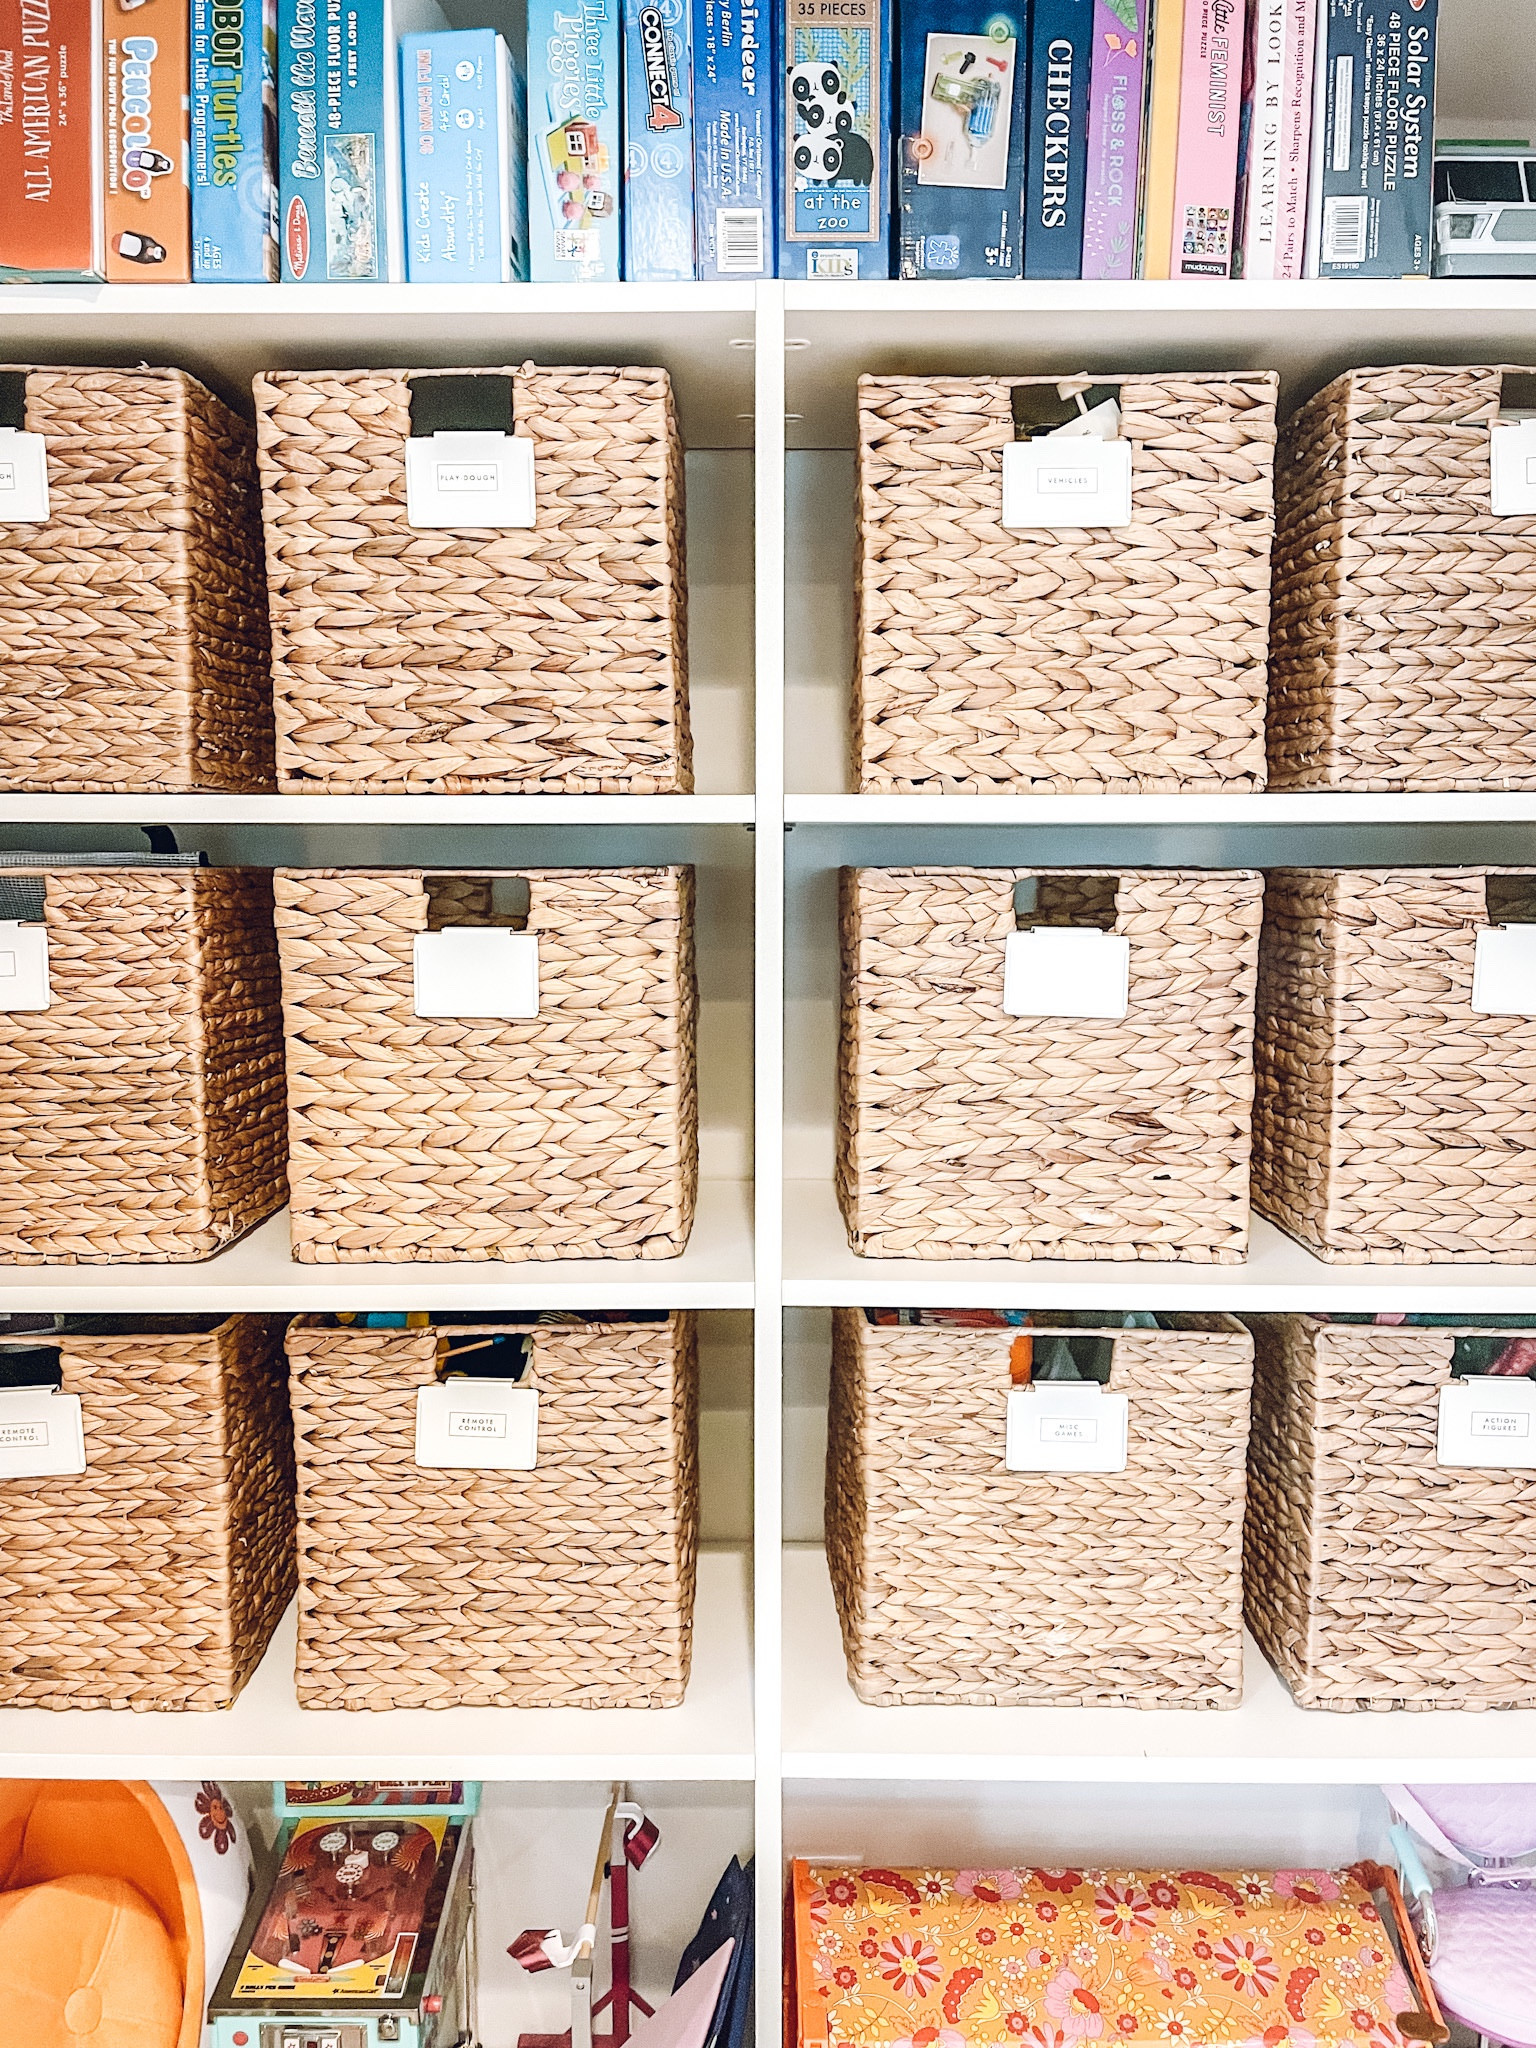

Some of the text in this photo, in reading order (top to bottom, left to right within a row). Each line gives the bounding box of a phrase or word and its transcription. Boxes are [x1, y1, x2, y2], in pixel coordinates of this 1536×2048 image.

[798, 3, 866, 16] 35 PIECES
[1201, 9, 1209, 29] PIECE
[327, 23, 341, 67] FLOOR
[722, 11, 733, 47] Berlin
[1200, 31, 1208, 58] PUZZLE
[1376, 33, 1386, 46] 36
[0, 49, 13, 72] Nod
[58, 44, 69, 78] puzzle
[108, 38, 117, 55] THE
[347, 11, 358, 88] 4 FEET LONG
[551, 14, 585, 111] Piggies
[583, 0, 609, 118] Three Little
[108, 56, 117, 74] FUN
[290, 52, 316, 87] the
[642, 10, 681, 130] CONNECT 4
[1364, 63, 1372, 91] surface
[1376, 57, 1385, 71] 24
[108, 75, 118, 104] SOUTH
[327, 70, 341, 130] 48-PIECE
[437, 74, 451, 107] Cards!
[1207, 36, 1229, 137] FEMINIST
[1266, 80, 1279, 107] BY
[1362, 92, 1371, 115] keeps
[1383, 11, 1401, 191] 48 PIECE FLOOR PUZZLE
[1400, 25, 1429, 178] Solar System
[21, 55, 51, 159] AMERICAN
[108, 105, 118, 126] POLE
[192, 34, 210, 187] for Little Programmers!
[418, 86, 434, 131] MUCH
[211, 73, 244, 188] Turtles
[290, 88, 321, 179] Beneath
[719, 109, 732, 146] Made
[1041, 38, 1073, 228] CHECKERS
[1107, 75, 1128, 207] FLOSS & ROCK
[1361, 115, 1370, 140] puzzle
[1372, 139, 1381, 149] 61
[1282, 16, 1305, 279] 24 Pairs to Match Sharpens Recognition and
[1360, 141, 1369, 169] looking
[1371, 150, 1380, 166] cm)
[25, 165, 51, 202] ALL
[720, 163, 733, 200] U.S.A.
[1260, 123, 1278, 243] LEARNING
[1360, 170, 1368, 188] new!
[804, 194, 861, 210] at the
[415, 181, 432, 264] Kids Create
[439, 193, 459, 262] Absurdity
[817, 217, 849, 230] zoo
[202, 259, 211, 270] up
[203, 243, 212, 257] and
[212, 245, 222, 270] AGES
[985, 246, 999, 266] 3+
[1413, 234, 1422, 271] AGES 3+
[2, 1427, 35, 1435] REMOTE
